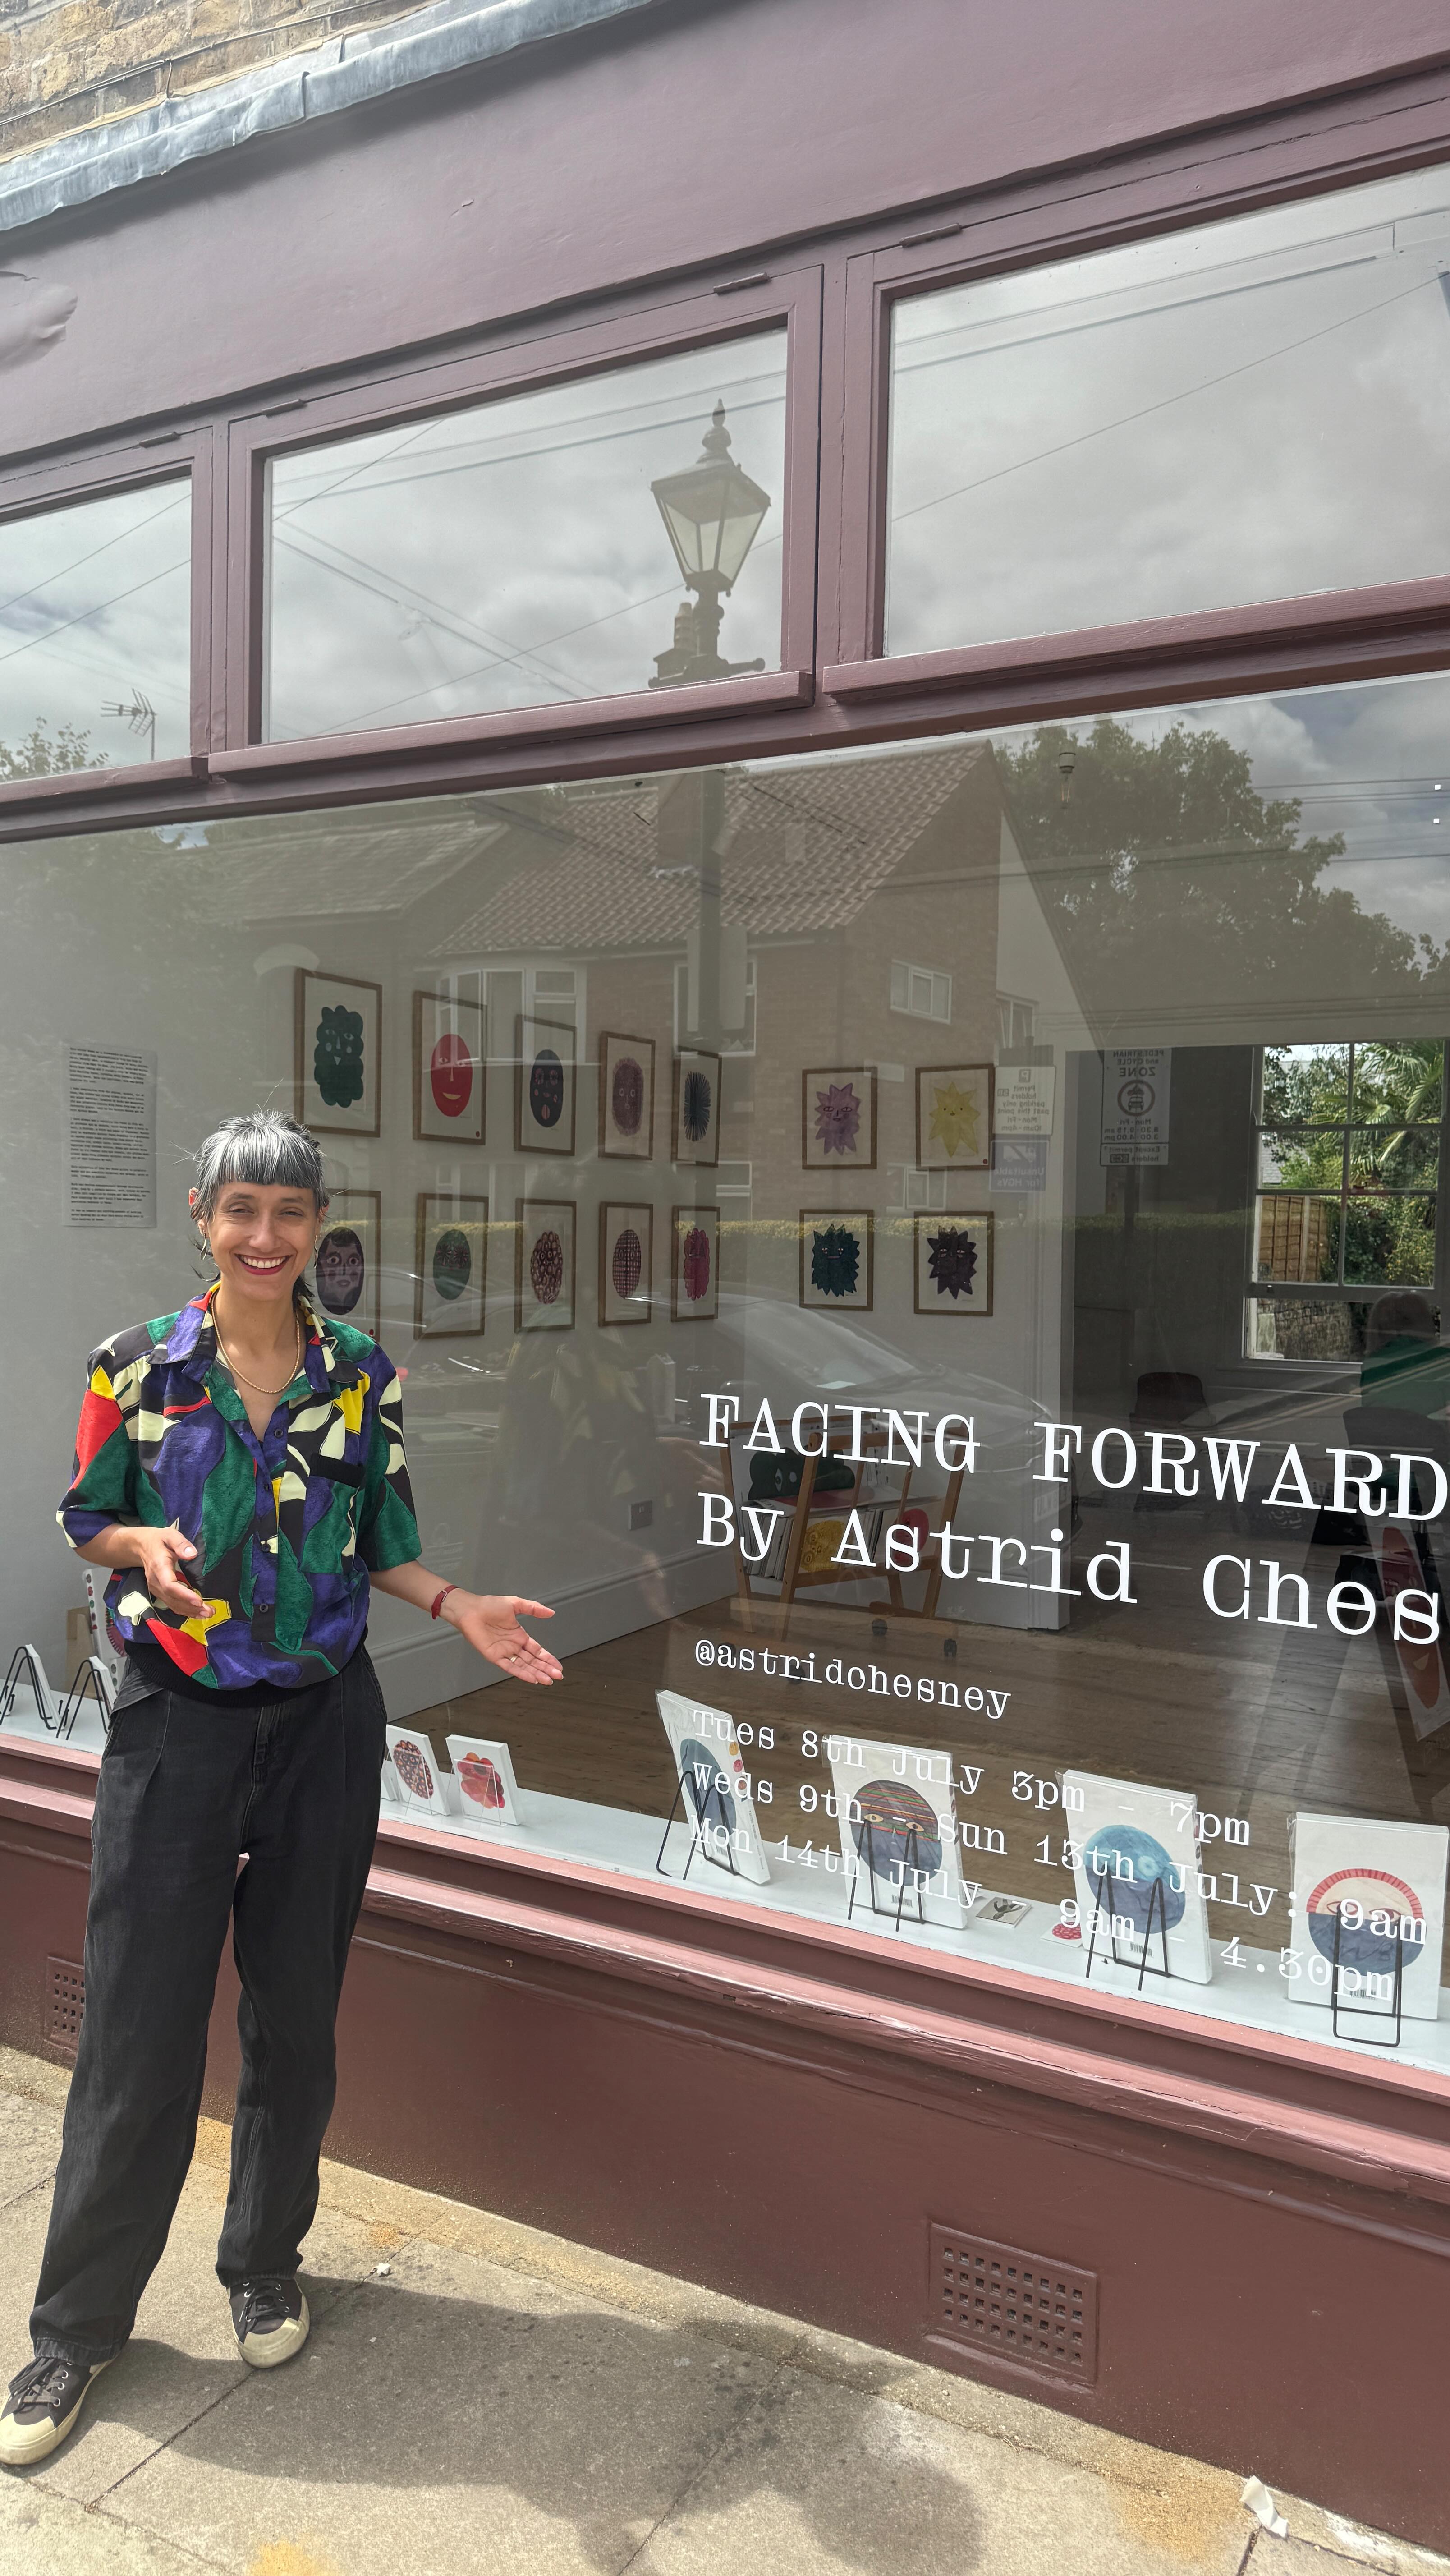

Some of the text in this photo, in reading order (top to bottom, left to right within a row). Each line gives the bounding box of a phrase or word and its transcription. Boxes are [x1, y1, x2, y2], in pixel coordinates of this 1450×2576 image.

[699, 1393, 1448, 1521] FACING FORWARD
[697, 1492, 1440, 1645] By Astrid Ches
[695, 1639, 1012, 1720] @astridchesney
[693, 1710, 775, 1750] Tues
[801, 1730, 866, 1768] 8th
[892, 1747, 985, 1795] July
[1011, 1770, 1085, 1812] 3pm
[1170, 1800, 1250, 1846] 7pm
[690, 1814, 753, 1854] Mon
[775, 1835, 863, 1879] 14th
[889, 1858, 982, 1909] July
[1060, 1898, 1135, 1941] 9am
[1220, 1936, 1393, 2002] 4.30pm
[692, 1762, 773, 1804] Weds
[799, 1785, 865, 1824] 9th
[937, 1813, 1008, 1855] Sun
[1034, 1835, 1138, 1883] 13th
[1340, 1898, 1427, 1945] 9am
